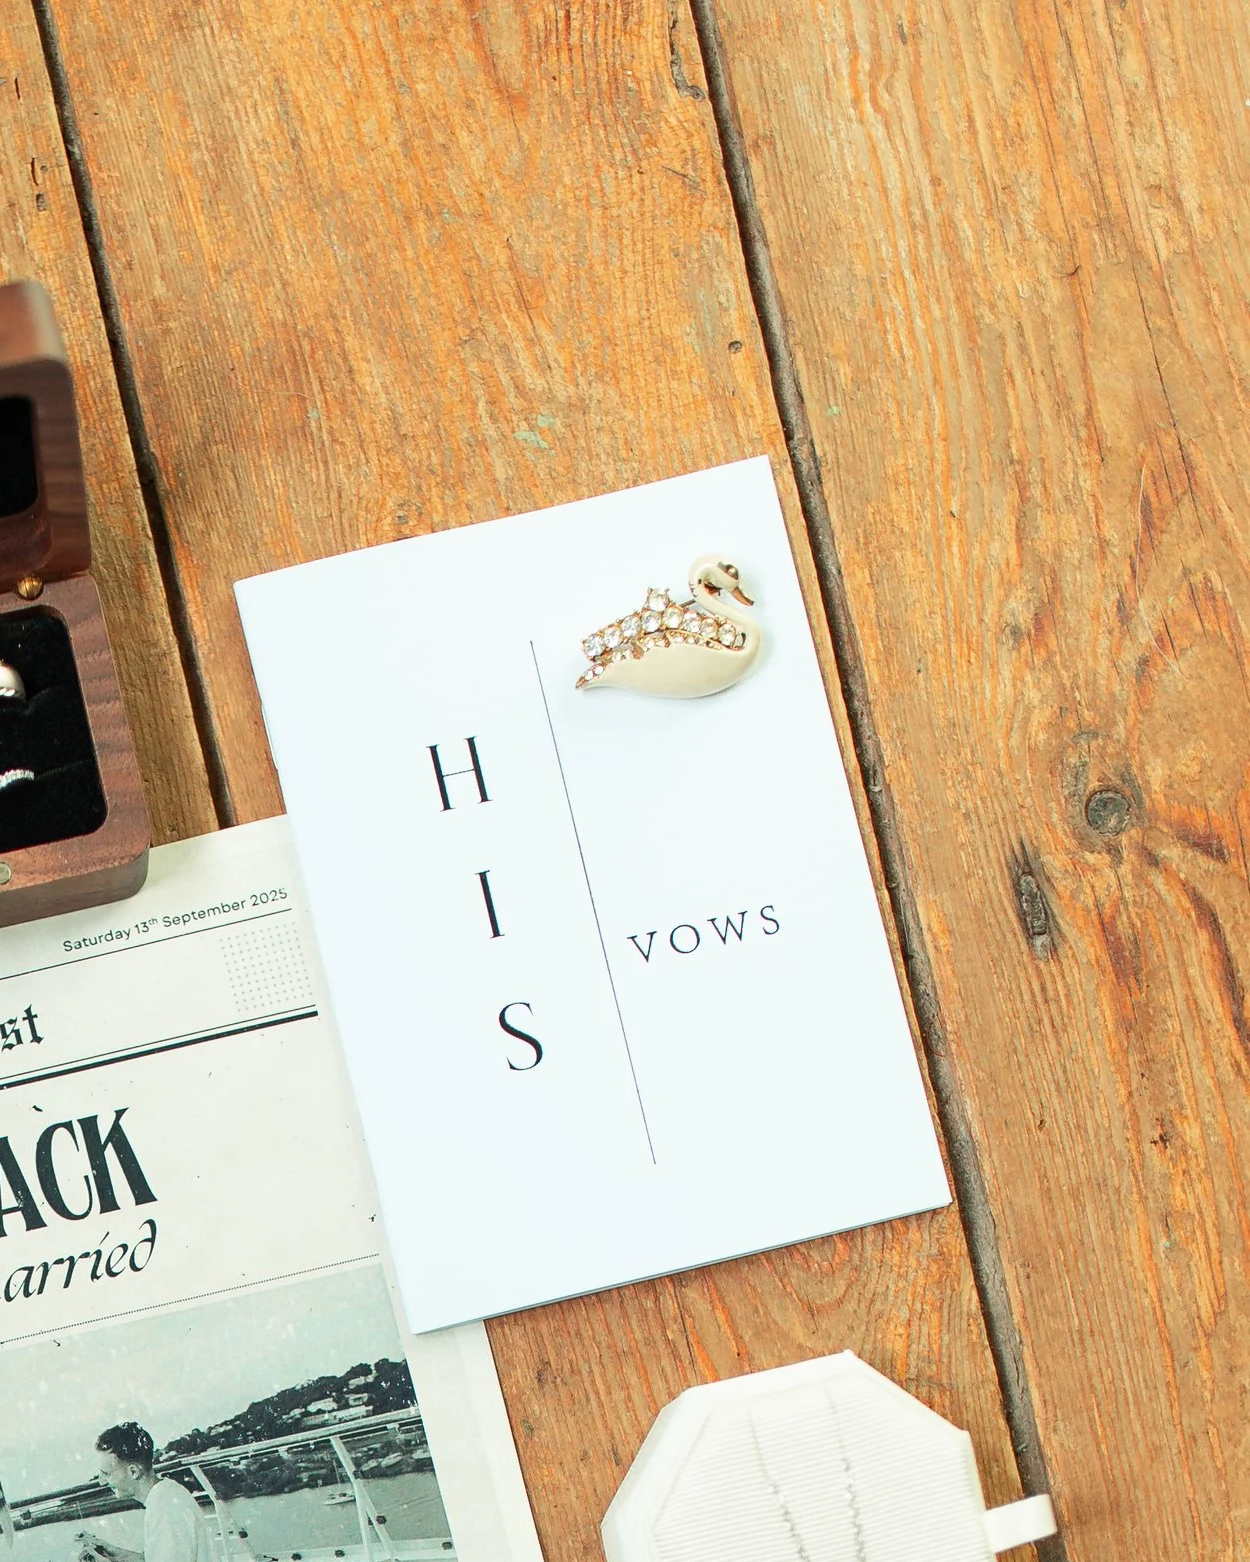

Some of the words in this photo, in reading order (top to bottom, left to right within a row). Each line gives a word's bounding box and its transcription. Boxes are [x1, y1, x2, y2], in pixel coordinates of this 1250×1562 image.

[62, 928, 131, 952] Saturday
[162, 899, 246, 928] September
[249, 888, 288, 907] 2025
[626, 904, 780, 963] VOWS
